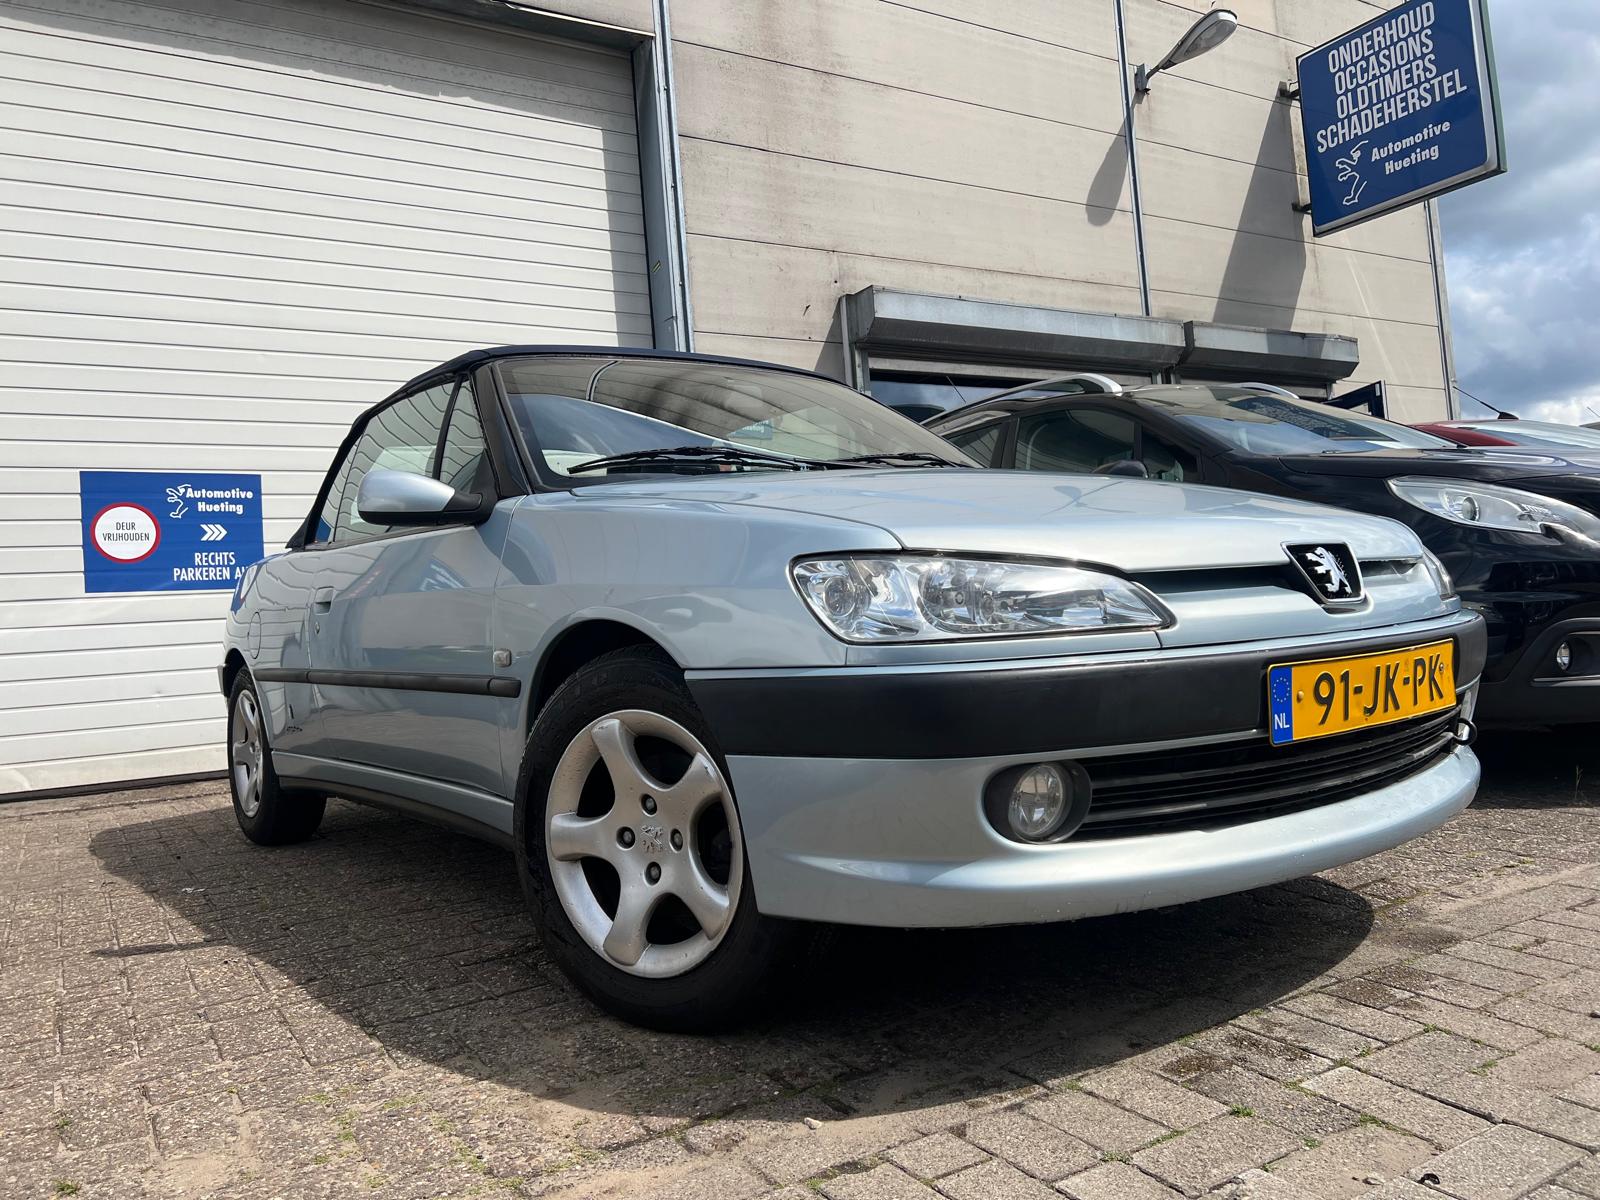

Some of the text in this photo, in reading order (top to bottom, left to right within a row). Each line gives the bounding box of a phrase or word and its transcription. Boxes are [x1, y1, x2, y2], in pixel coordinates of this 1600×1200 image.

[1328, 1, 1435, 73] ONDERHOUD
[1334, 28, 1434, 95] OCCASIONS
[1336, 53, 1437, 119] OLDTIMERS
[1316, 68, 1468, 154] SCHADEHERSTEL
[1371, 120, 1451, 162] Automotive
[1385, 145, 1439, 175] Hueting
[185, 487, 254, 500] Automotive
[197, 501, 244, 515] Hueting
[102, 532, 150, 542] VRIJHOUDEN
[115, 521, 136, 531] DEUR
[194, 551, 236, 566] RECHTS
[173, 566, 231, 581] PARKEREN
[1313, 653, 1444, 726] 91-JK-PK
[1274, 712, 1290, 730] NL
